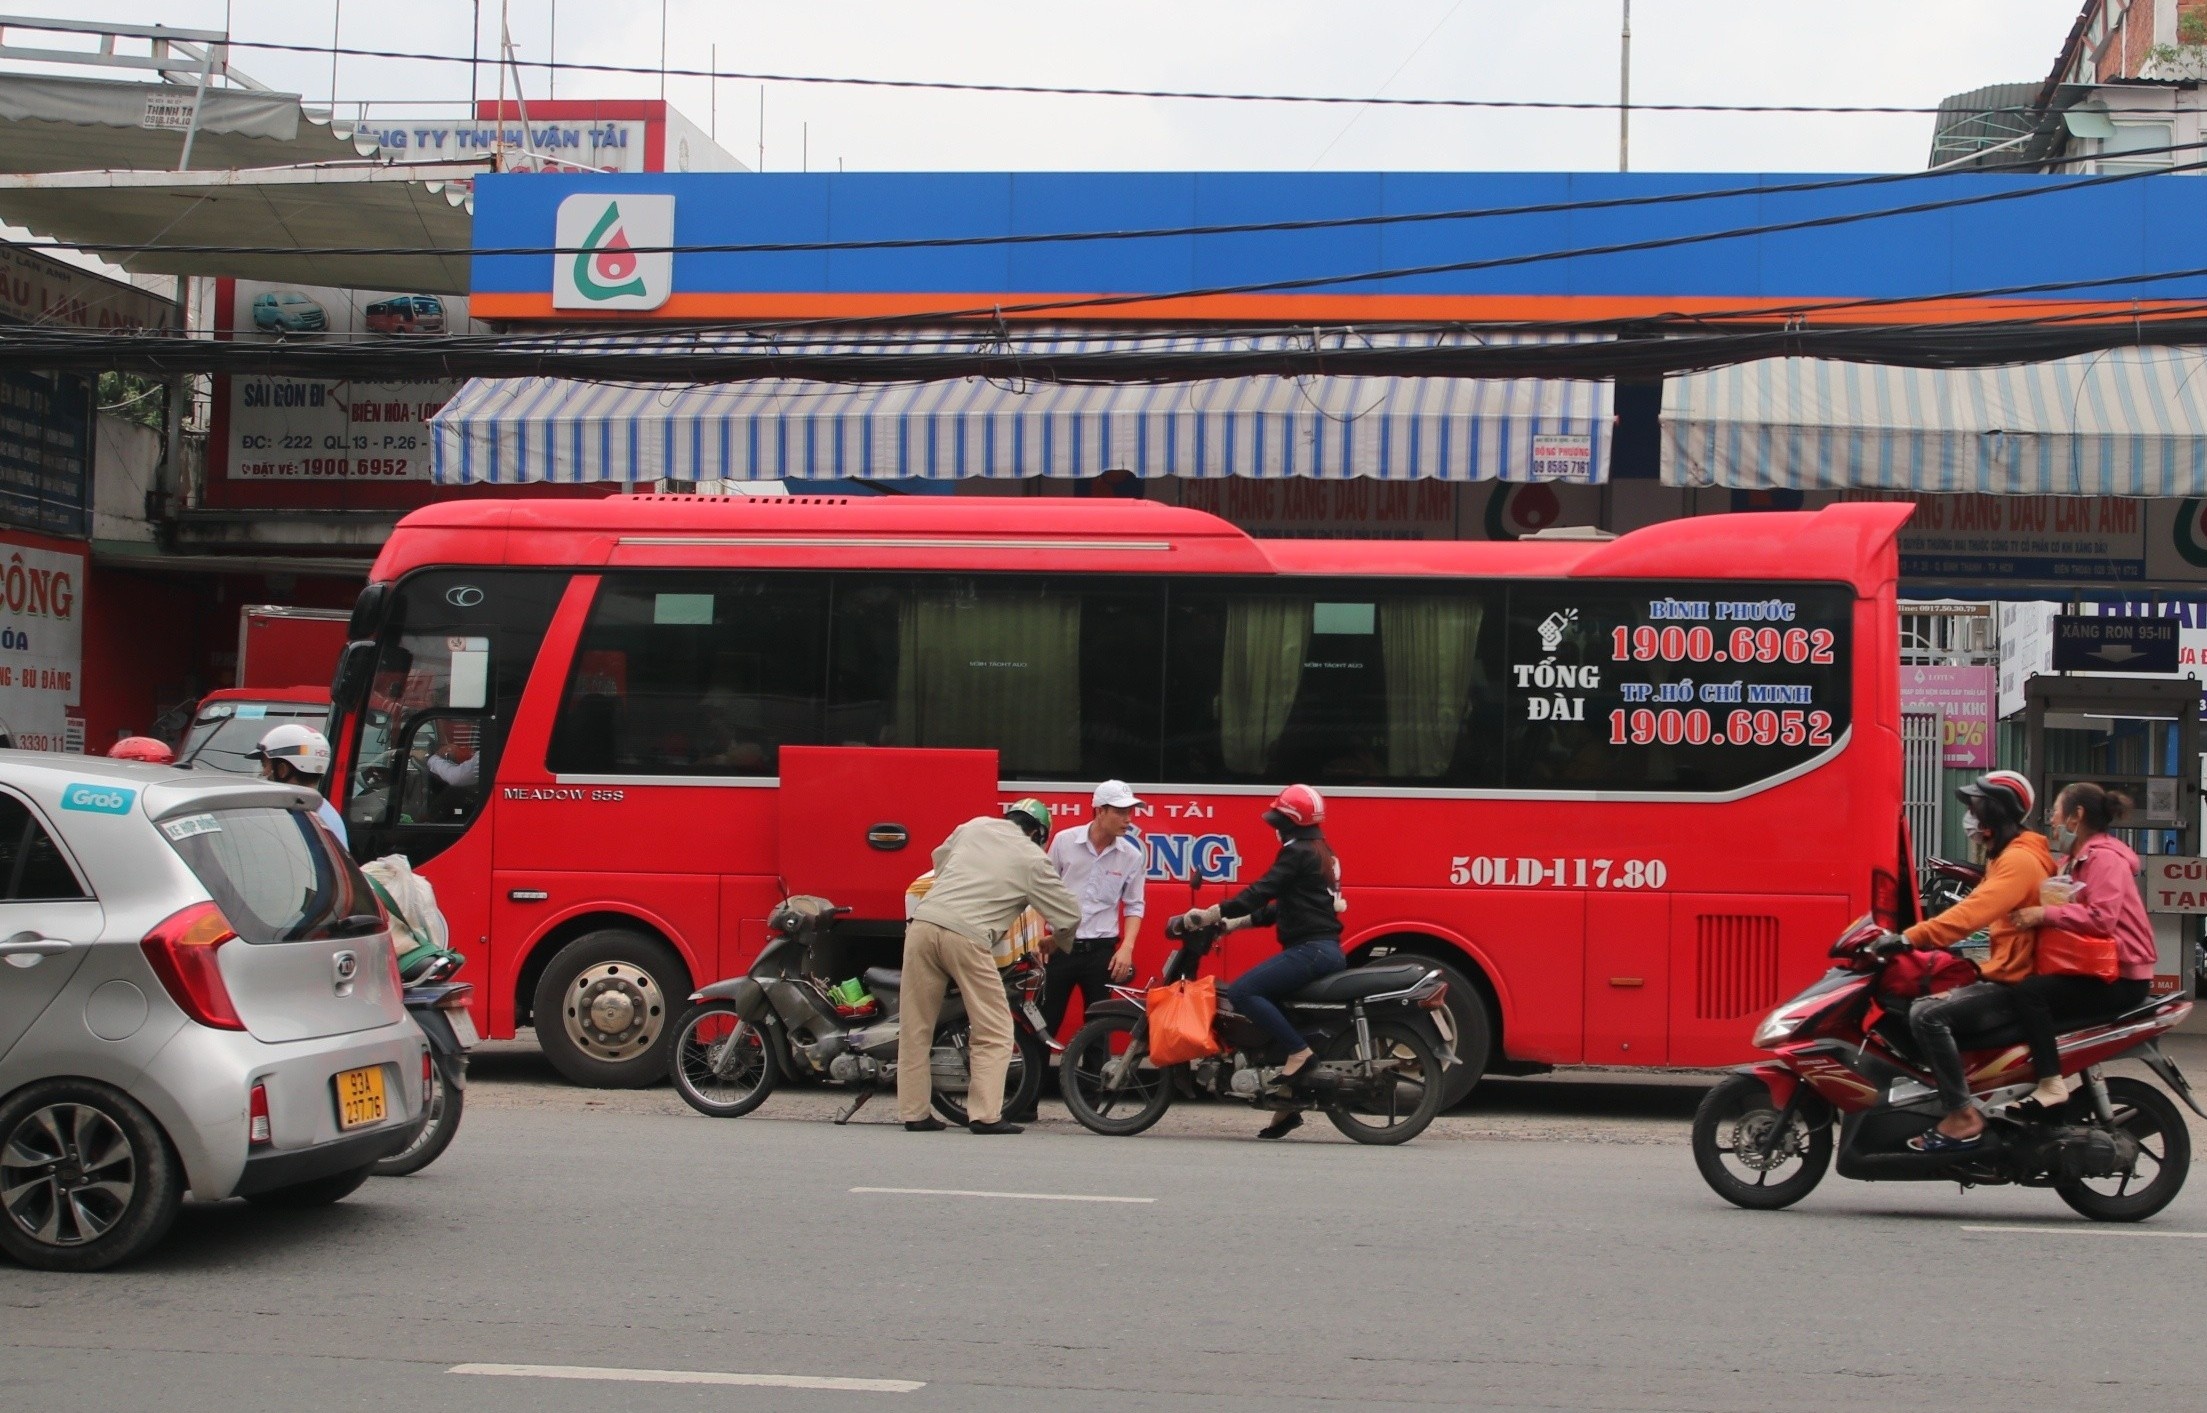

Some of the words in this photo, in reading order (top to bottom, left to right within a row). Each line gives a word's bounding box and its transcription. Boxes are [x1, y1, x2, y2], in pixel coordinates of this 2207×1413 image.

[414, 129, 448, 149] TY
[456, 128, 524, 149] TNHH
[531, 124, 580, 152] VẬN
[589, 122, 628, 149] TẢI
[244, 378, 270, 408] SÀI
[273, 378, 306, 408] GÒN
[309, 383, 326, 408] ĐI
[351, 400, 381, 423] BIÊN
[384, 398, 409, 423] HÒA
[242, 434, 272, 450] ĐC:
[284, 435, 313, 450] 222
[384, 436, 416, 451] P.26
[253, 461, 275, 477] ĐẶT
[302, 458, 407, 476] 1900.6952
[2100, 497, 2138, 535] ANH
[1649, 597, 1710, 620] BÌNH
[1715, 598, 1796, 622] PHƯỚC
[2062, 621, 2100, 639] XĂNG
[2106, 625, 2133, 639] RON
[2138, 626, 2171, 640] 95-III
[1611, 626, 1834, 664] 1900.6962
[41, 667, 72, 691] ĐĂNG
[1513, 655, 1601, 689] TỔNG
[1699, 681, 1743, 703] CHÍ
[1747, 684, 1813, 704] MINH
[1527, 692, 1586, 721] ĐÀI
[1609, 708, 1832, 747] 1900.6952
[73, 789, 123, 809] Grab
[504, 788, 586, 800] MEADOW
[997, 802, 1080, 816] THH
[1164, 801, 1213, 818] TẢI
[1449, 856, 1667, 889] 50LD-117.80
[2164, 860, 2207, 880] CÚ
[351, 1071, 371, 1096] 93A
